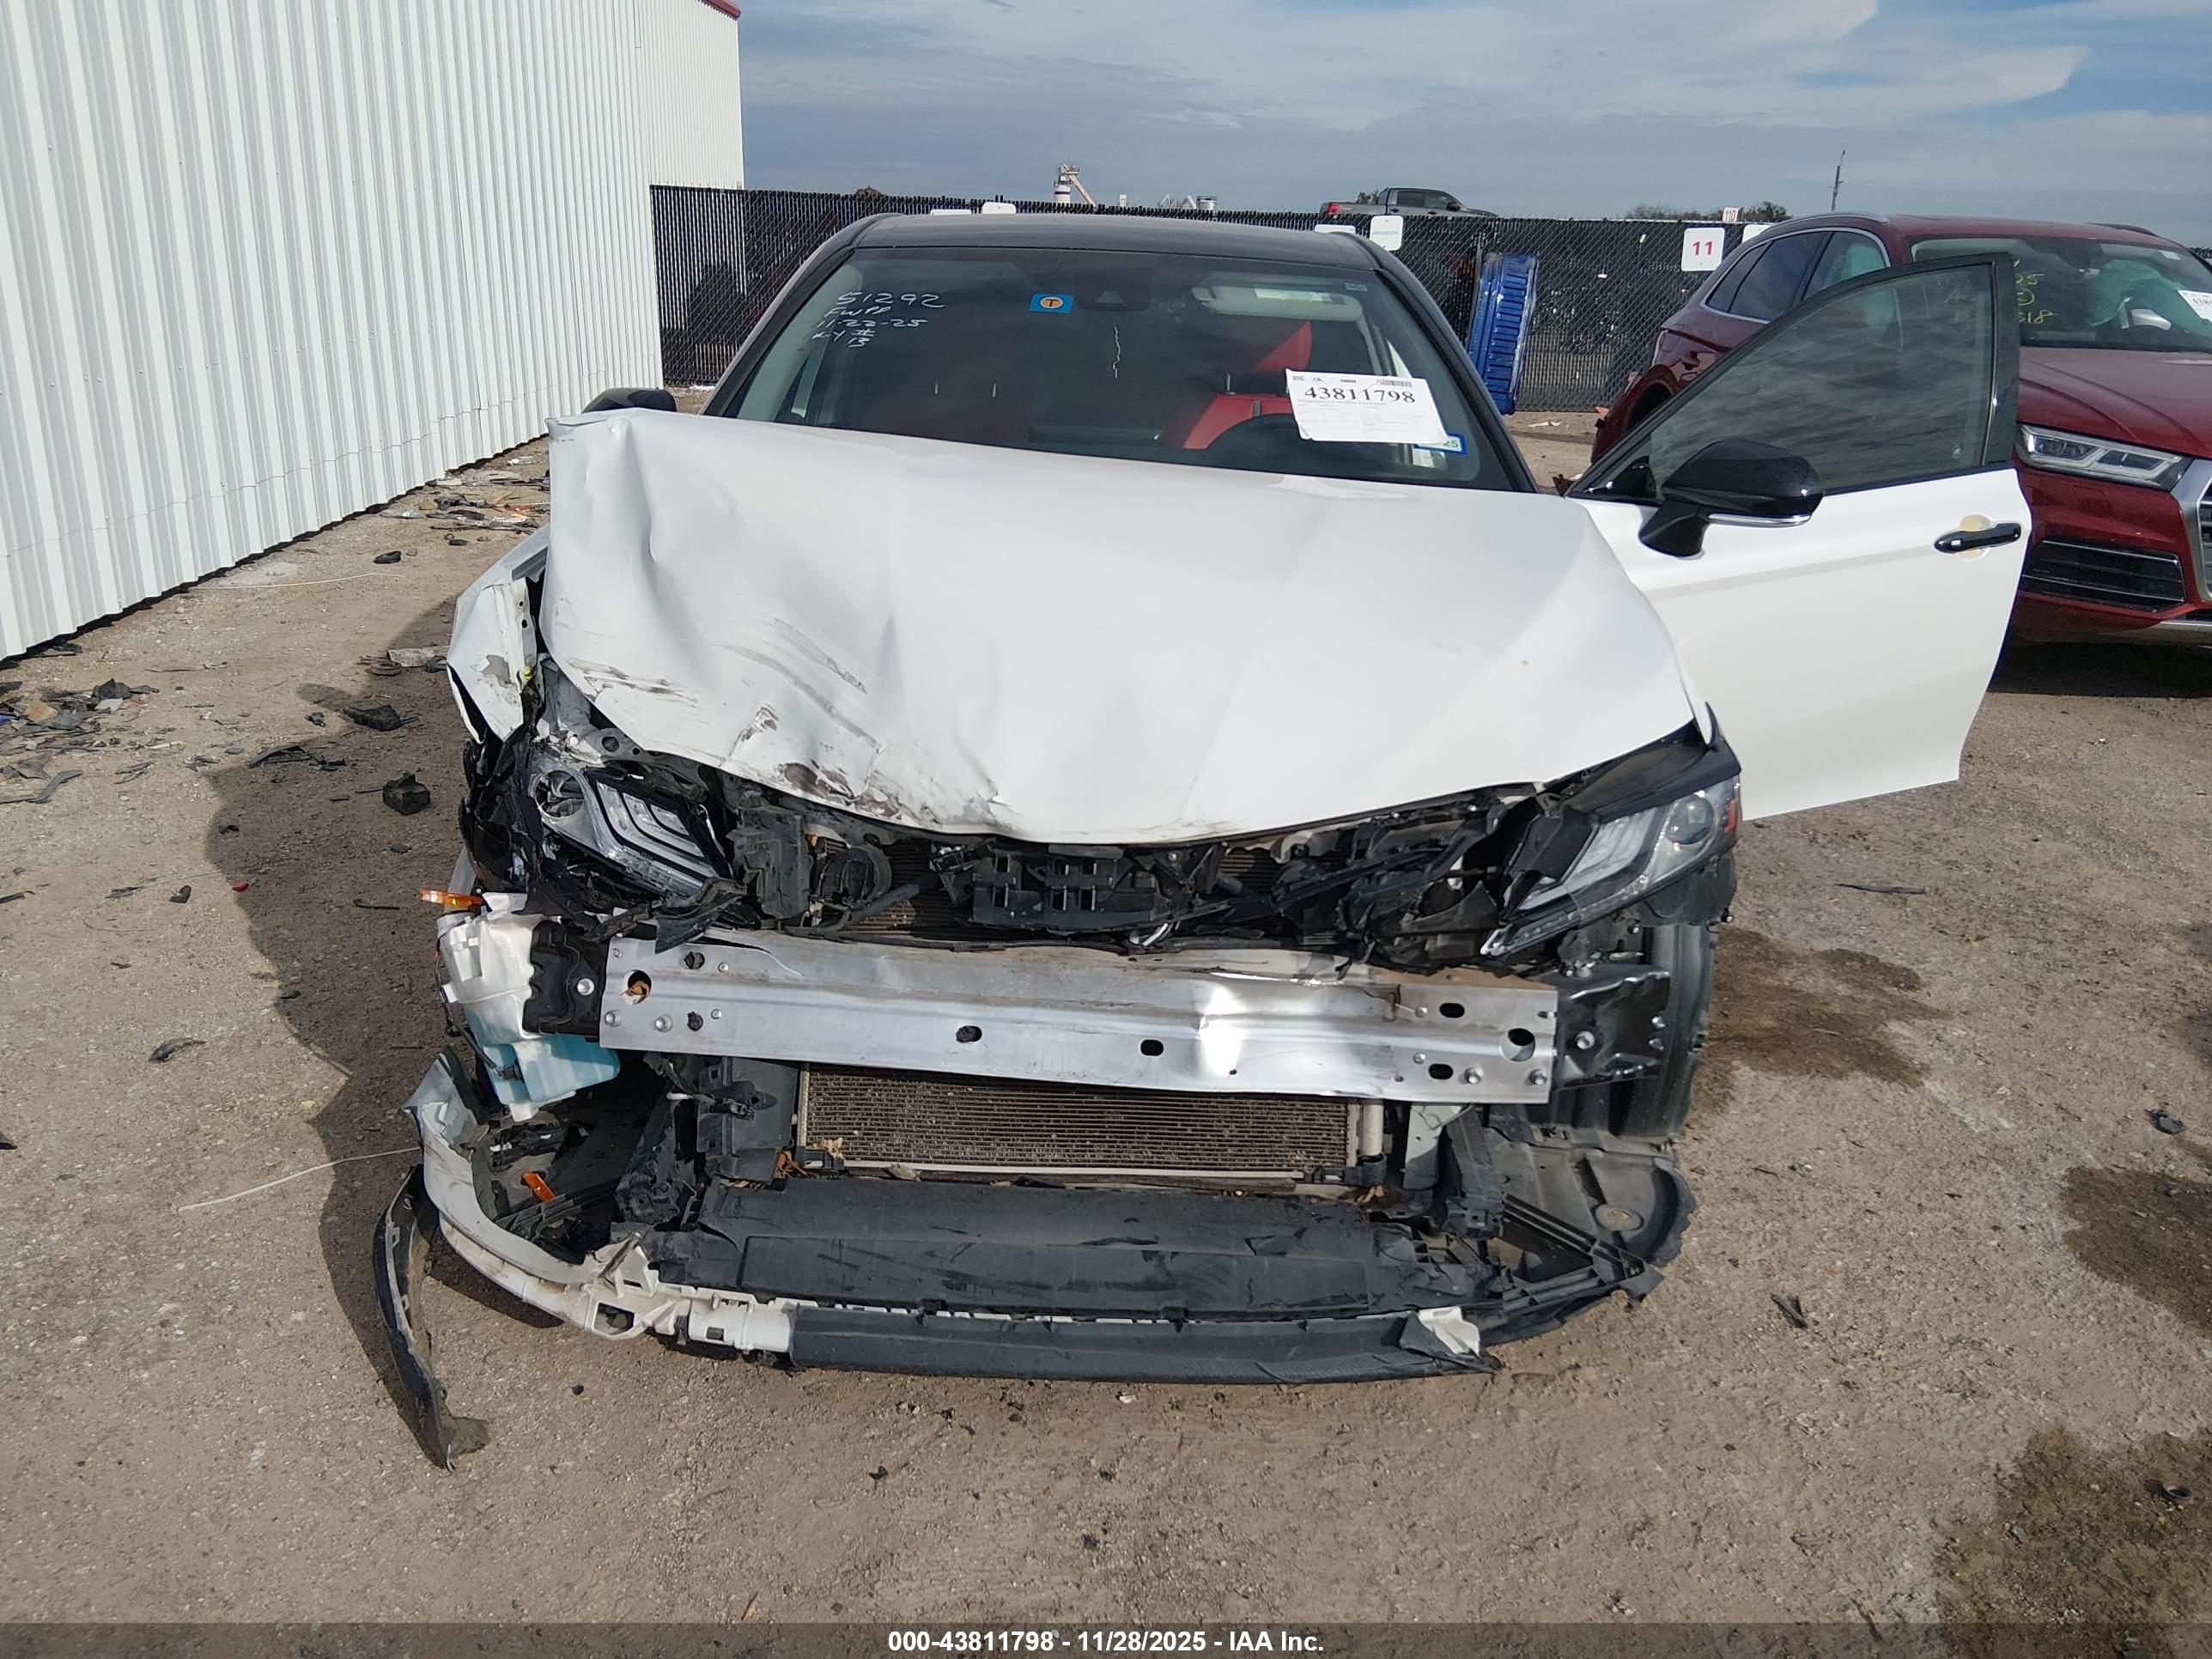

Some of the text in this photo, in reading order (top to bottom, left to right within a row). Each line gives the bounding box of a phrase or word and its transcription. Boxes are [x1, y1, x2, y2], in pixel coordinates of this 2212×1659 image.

[1692, 241, 1713, 255] 11
[836, 292, 945, 308] 51292
[1304, 386, 1416, 404] 43811798
